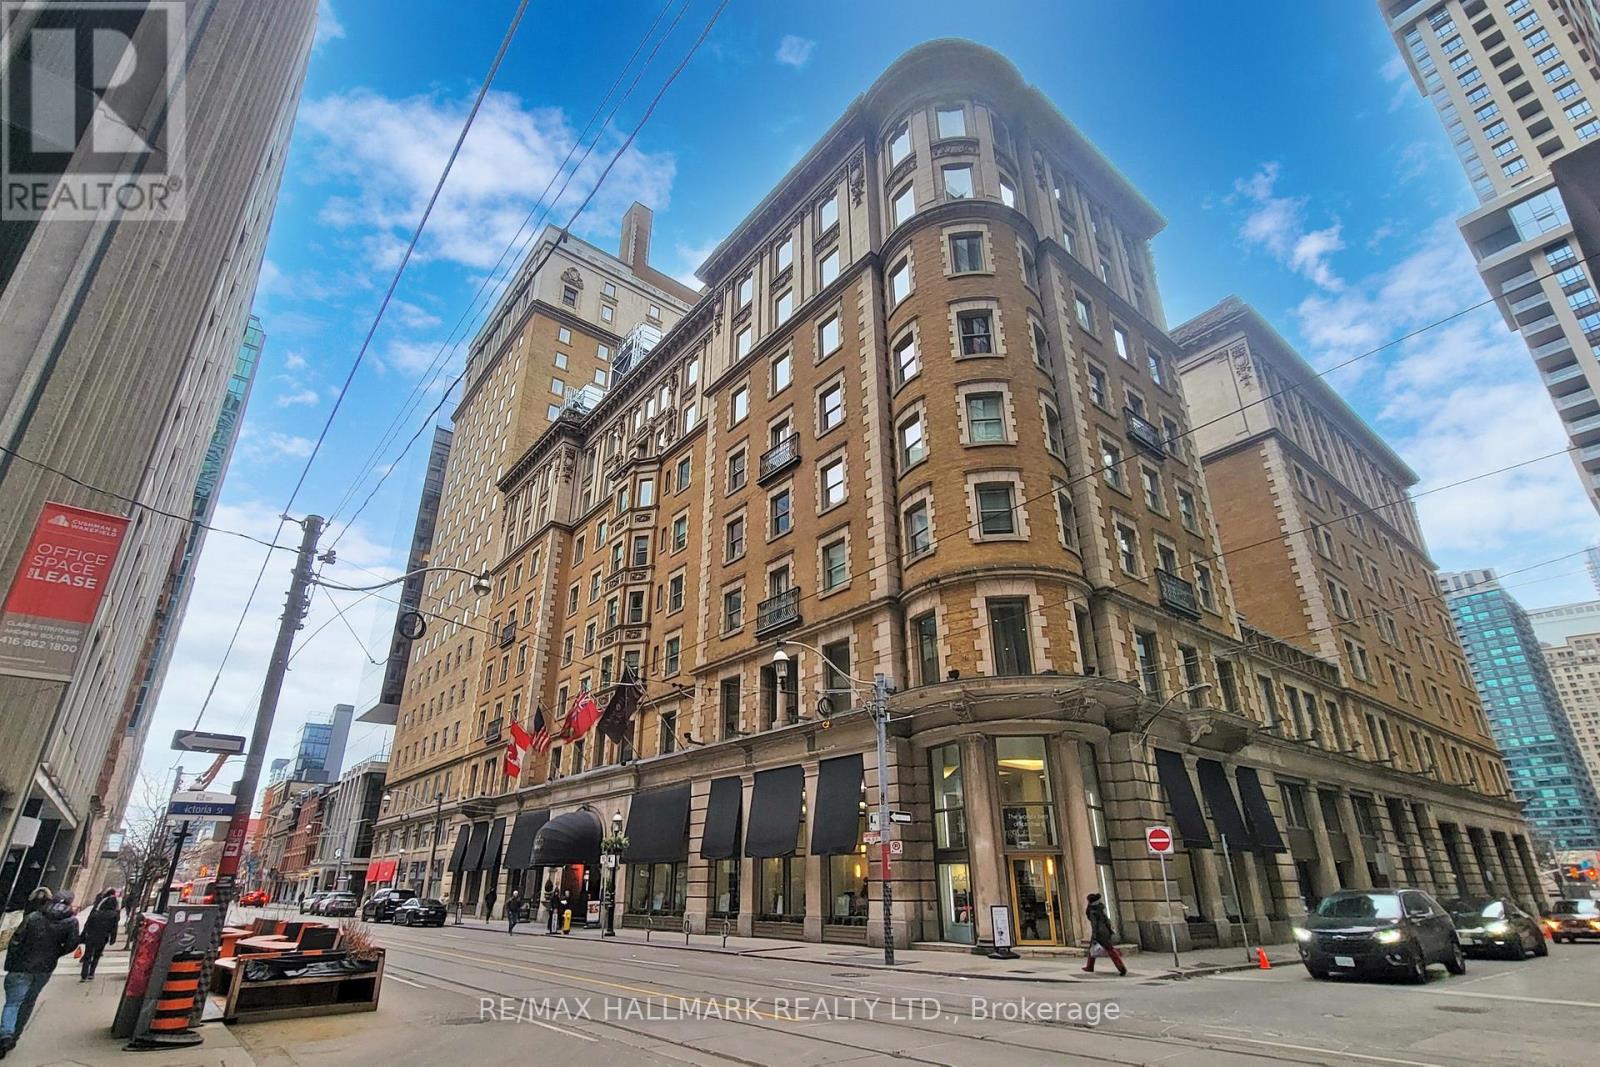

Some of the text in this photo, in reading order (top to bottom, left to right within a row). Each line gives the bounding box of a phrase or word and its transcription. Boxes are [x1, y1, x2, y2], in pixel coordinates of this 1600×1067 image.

[37, 543, 108, 566] OFFICE
[31, 555, 96, 576] SPACE
[33, 568, 98, 589] LEASE
[0, 636, 78, 653] 416 862 1800
[183, 804, 224, 815] ictoria St
